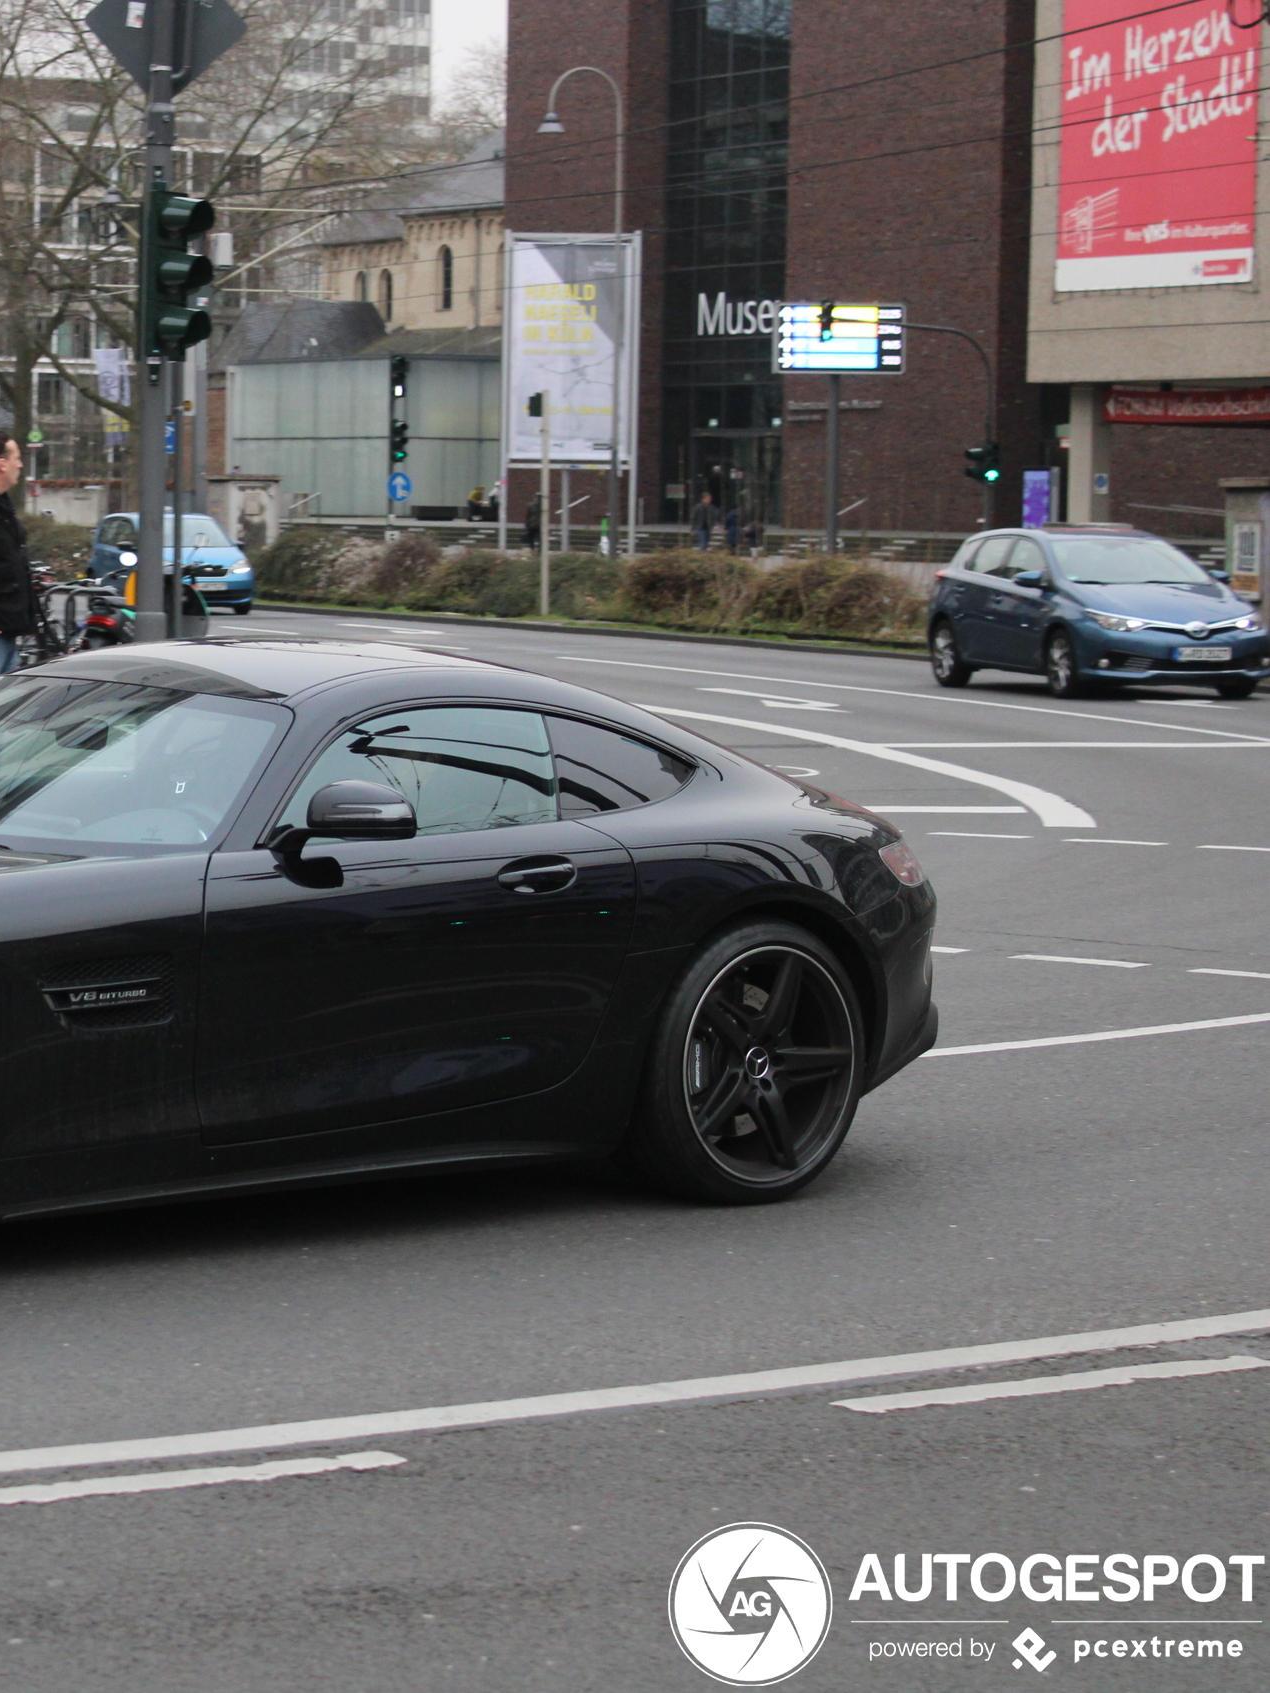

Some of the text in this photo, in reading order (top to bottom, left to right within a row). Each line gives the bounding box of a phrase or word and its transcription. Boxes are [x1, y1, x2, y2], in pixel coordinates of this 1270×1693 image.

[1065, 10, 1233, 100] Im Herzen
[1092, 48, 1255, 157] der Stadt!
[524, 284, 597, 301] HARALD
[524, 305, 597, 322] NAEGELI
[697, 291, 775, 336] Muse
[524, 321, 593, 342] IN KÖLN
[70, 989, 147, 1002] V8 BITURBO
